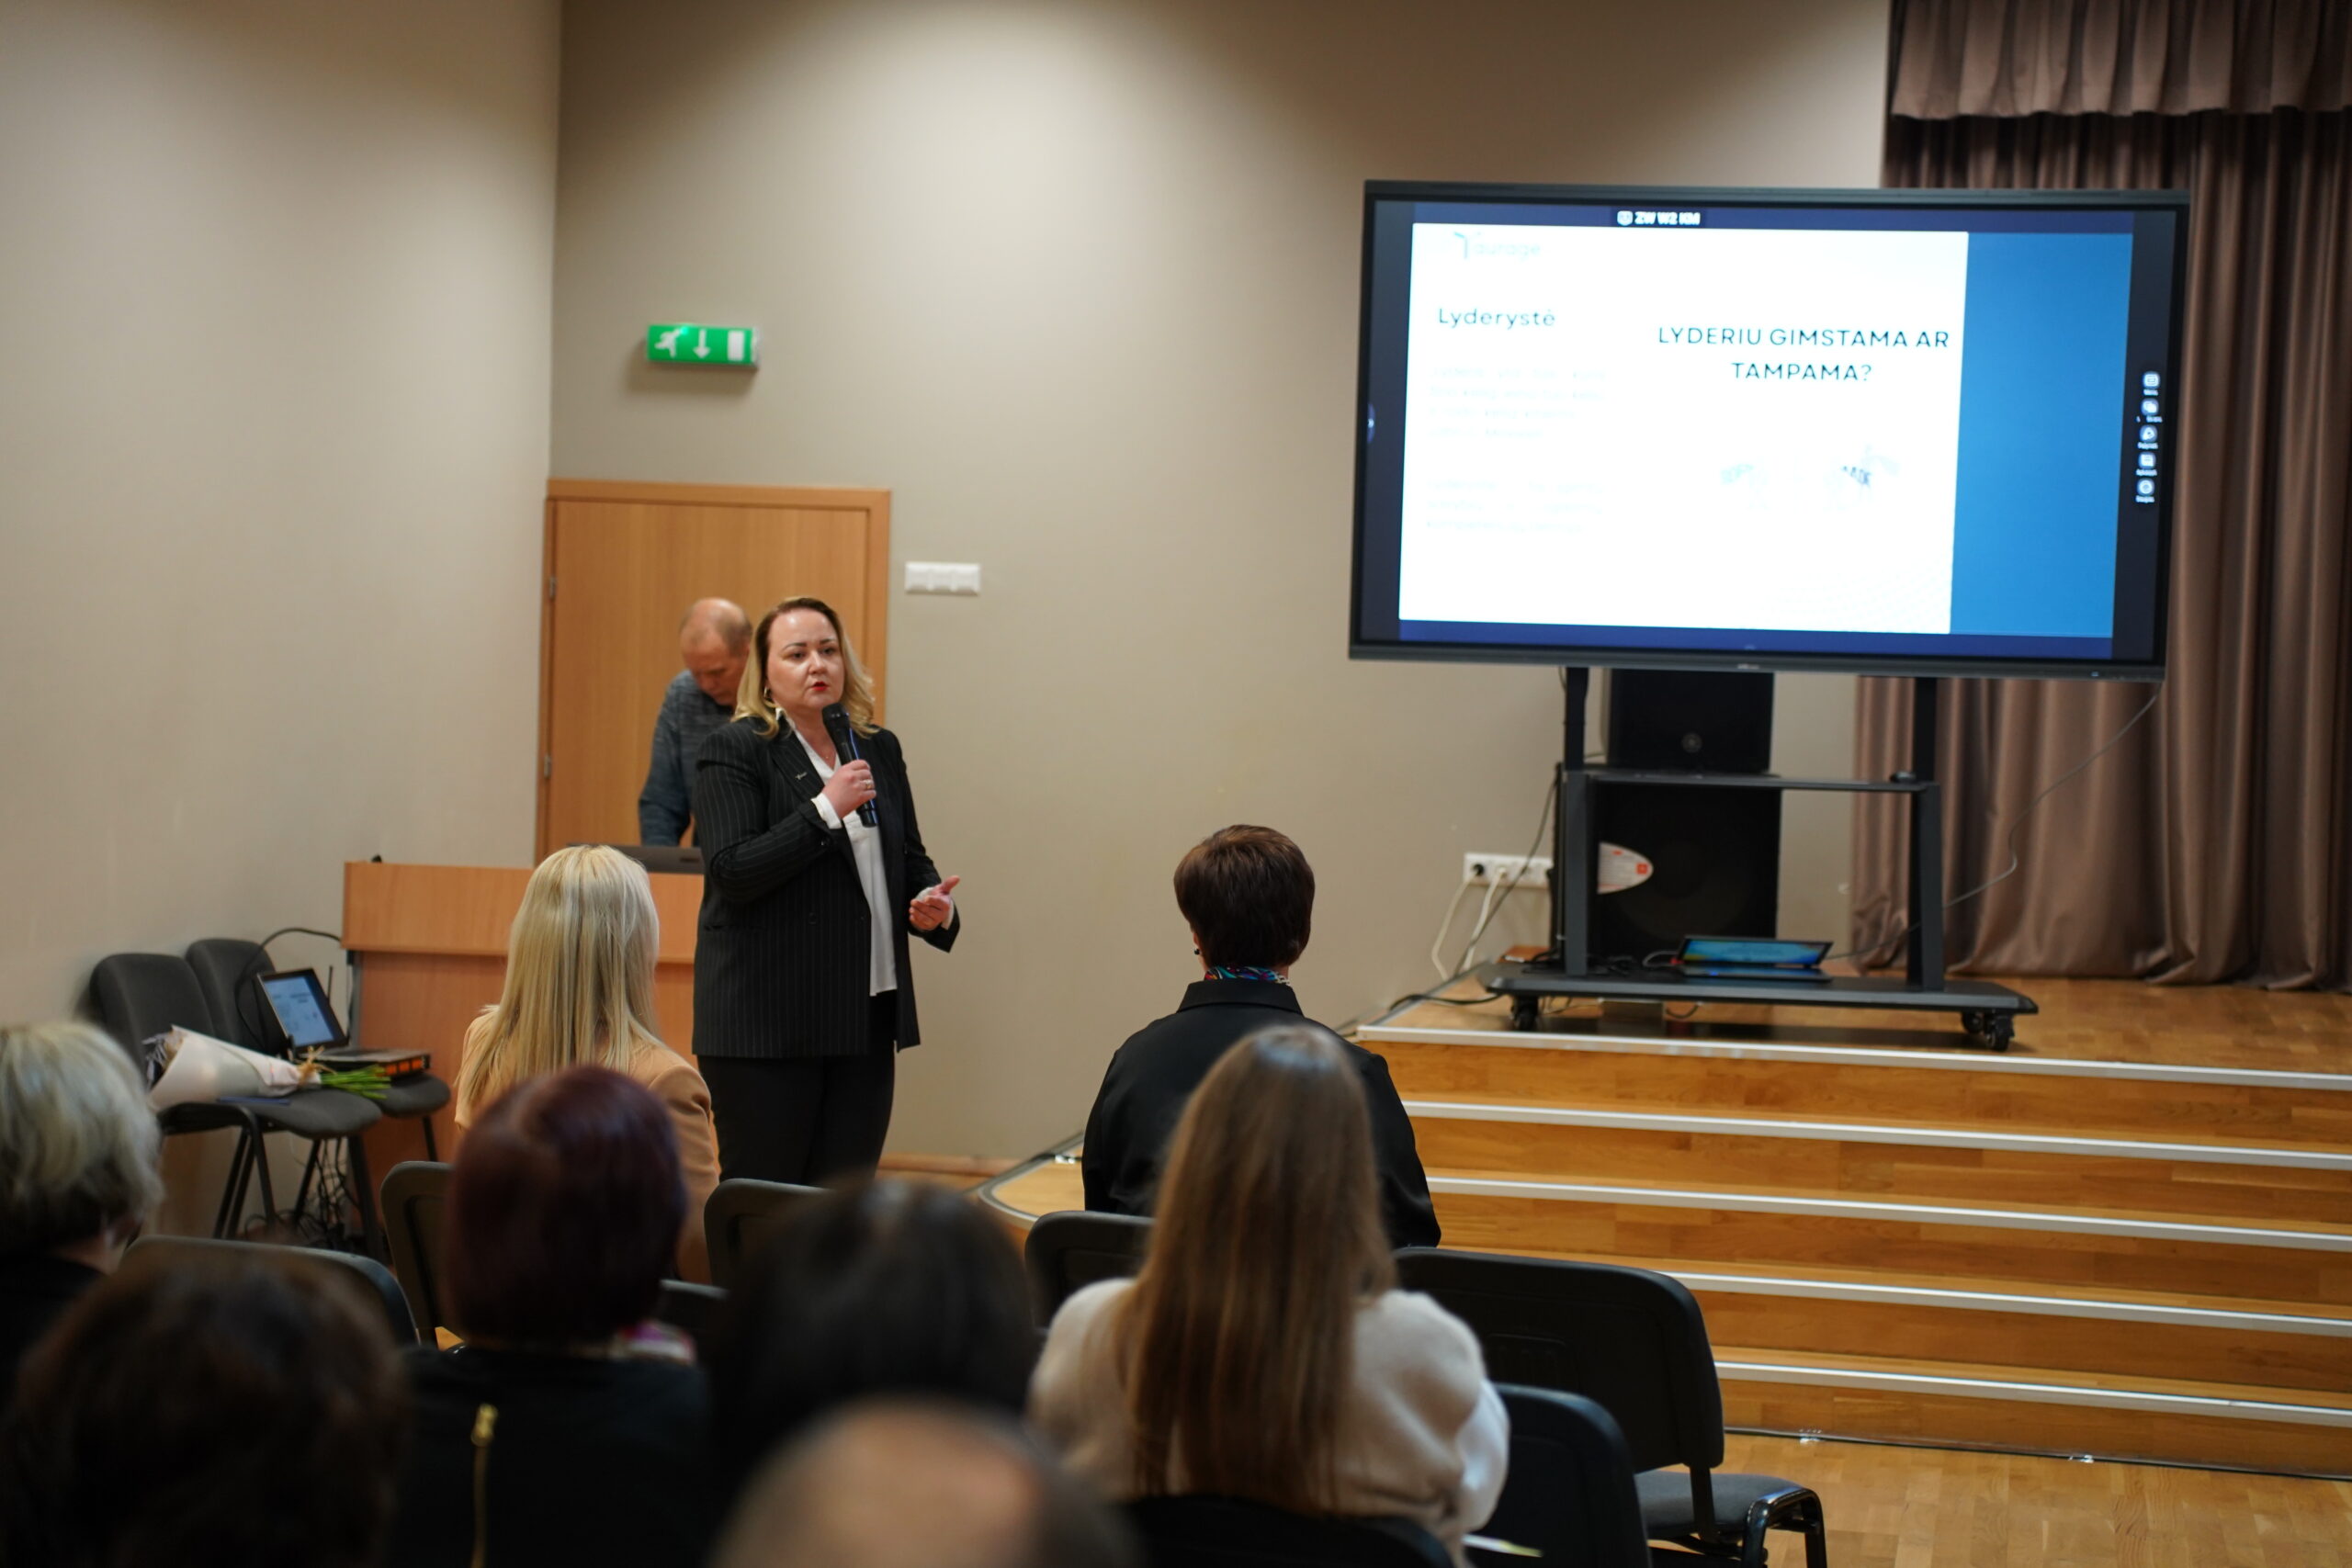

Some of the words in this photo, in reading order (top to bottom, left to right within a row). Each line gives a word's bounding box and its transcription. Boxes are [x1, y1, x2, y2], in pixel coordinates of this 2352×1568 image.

[1438, 308, 1556, 330] Lyderystė
[1658, 326, 1762, 345] LYDERIU
[1770, 328, 1908, 348] GIMSTAMA
[1915, 330, 1951, 349] AR
[1731, 361, 1872, 382] TAMPAMA?
